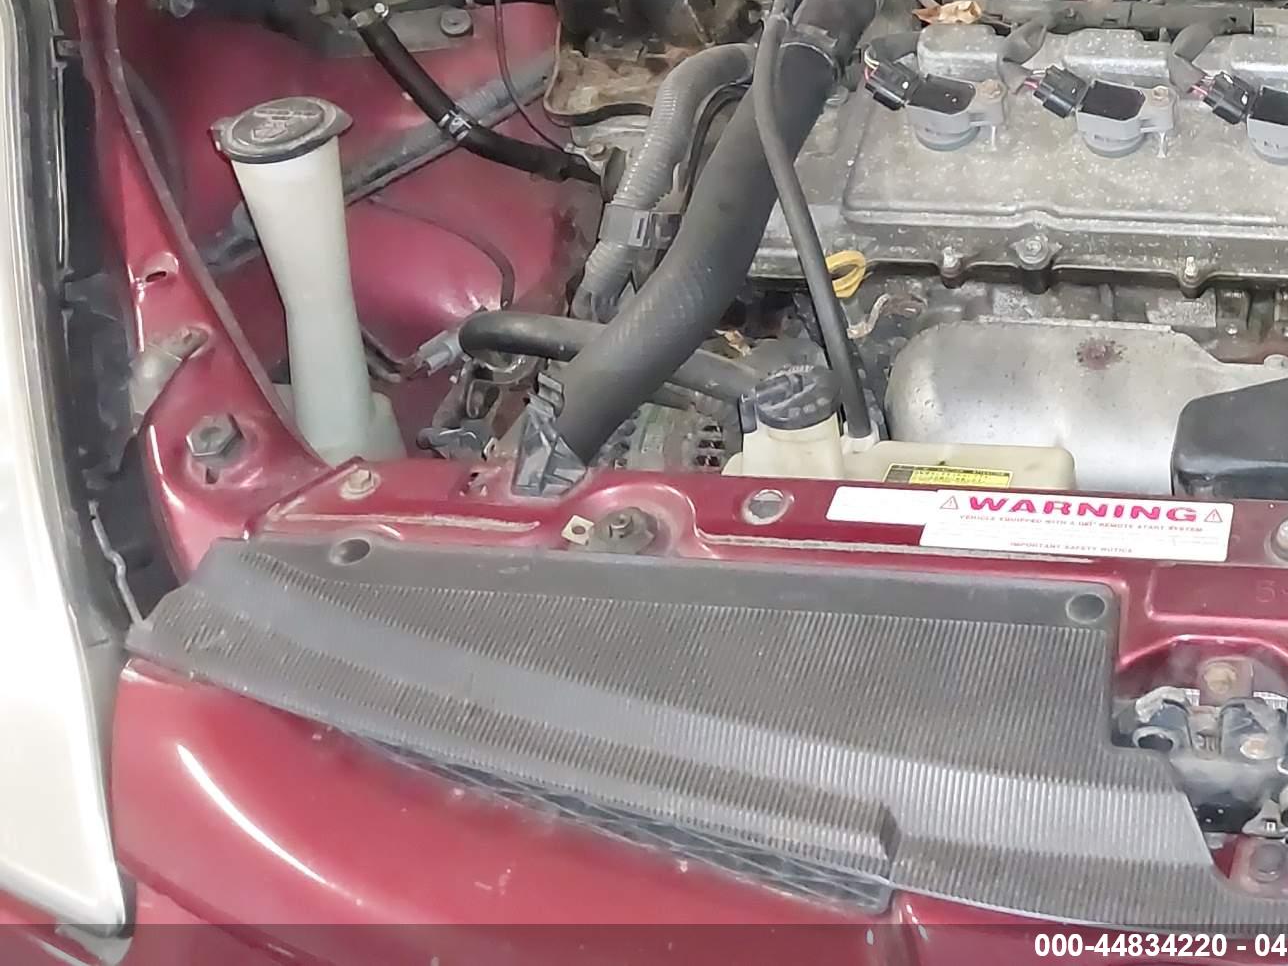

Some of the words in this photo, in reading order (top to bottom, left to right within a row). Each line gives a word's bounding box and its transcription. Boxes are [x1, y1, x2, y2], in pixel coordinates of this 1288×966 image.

[969, 496, 1197, 522] WARNING
[1099, 522, 1133, 530] REMOTE
[1168, 525, 1204, 533] SYSTEM
[1010, 541, 1061, 550] IMPORTANT
[1064, 544, 1097, 552] SAFETY
